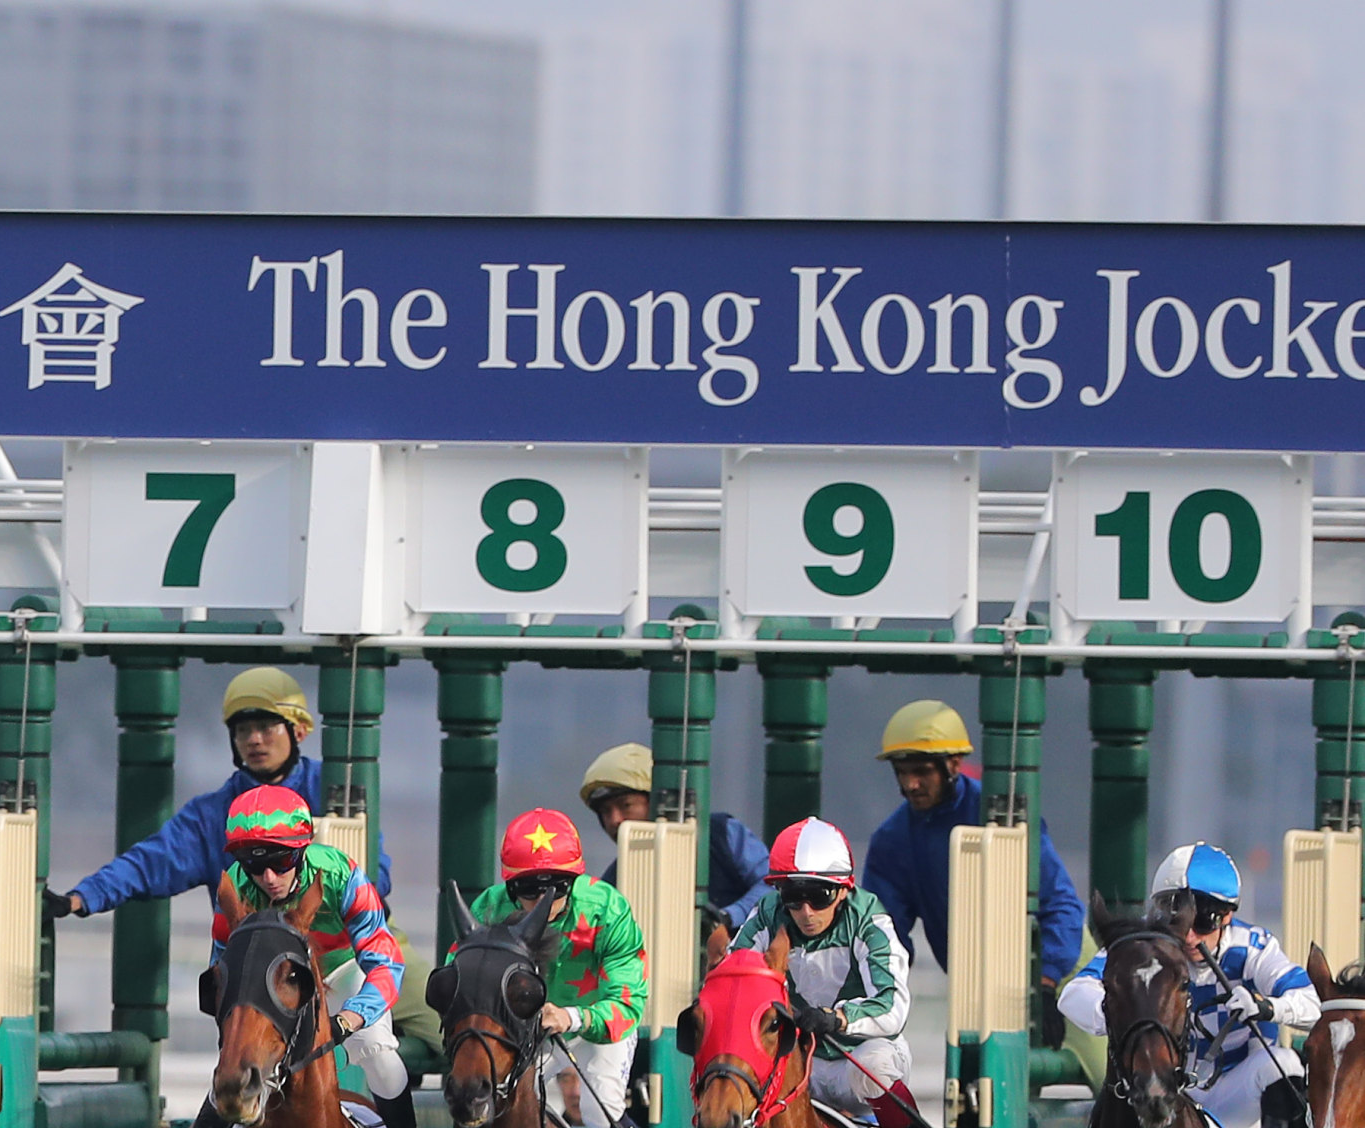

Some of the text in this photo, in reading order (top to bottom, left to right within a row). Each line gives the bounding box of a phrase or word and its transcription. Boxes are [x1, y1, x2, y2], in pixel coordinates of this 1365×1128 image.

[247, 249, 1365, 409] The Hong Kong Jocke
[146, 472, 235, 587] 7
[477, 478, 568, 592] 8
[804, 482, 895, 596] 9
[1096, 489, 1262, 602] 10
